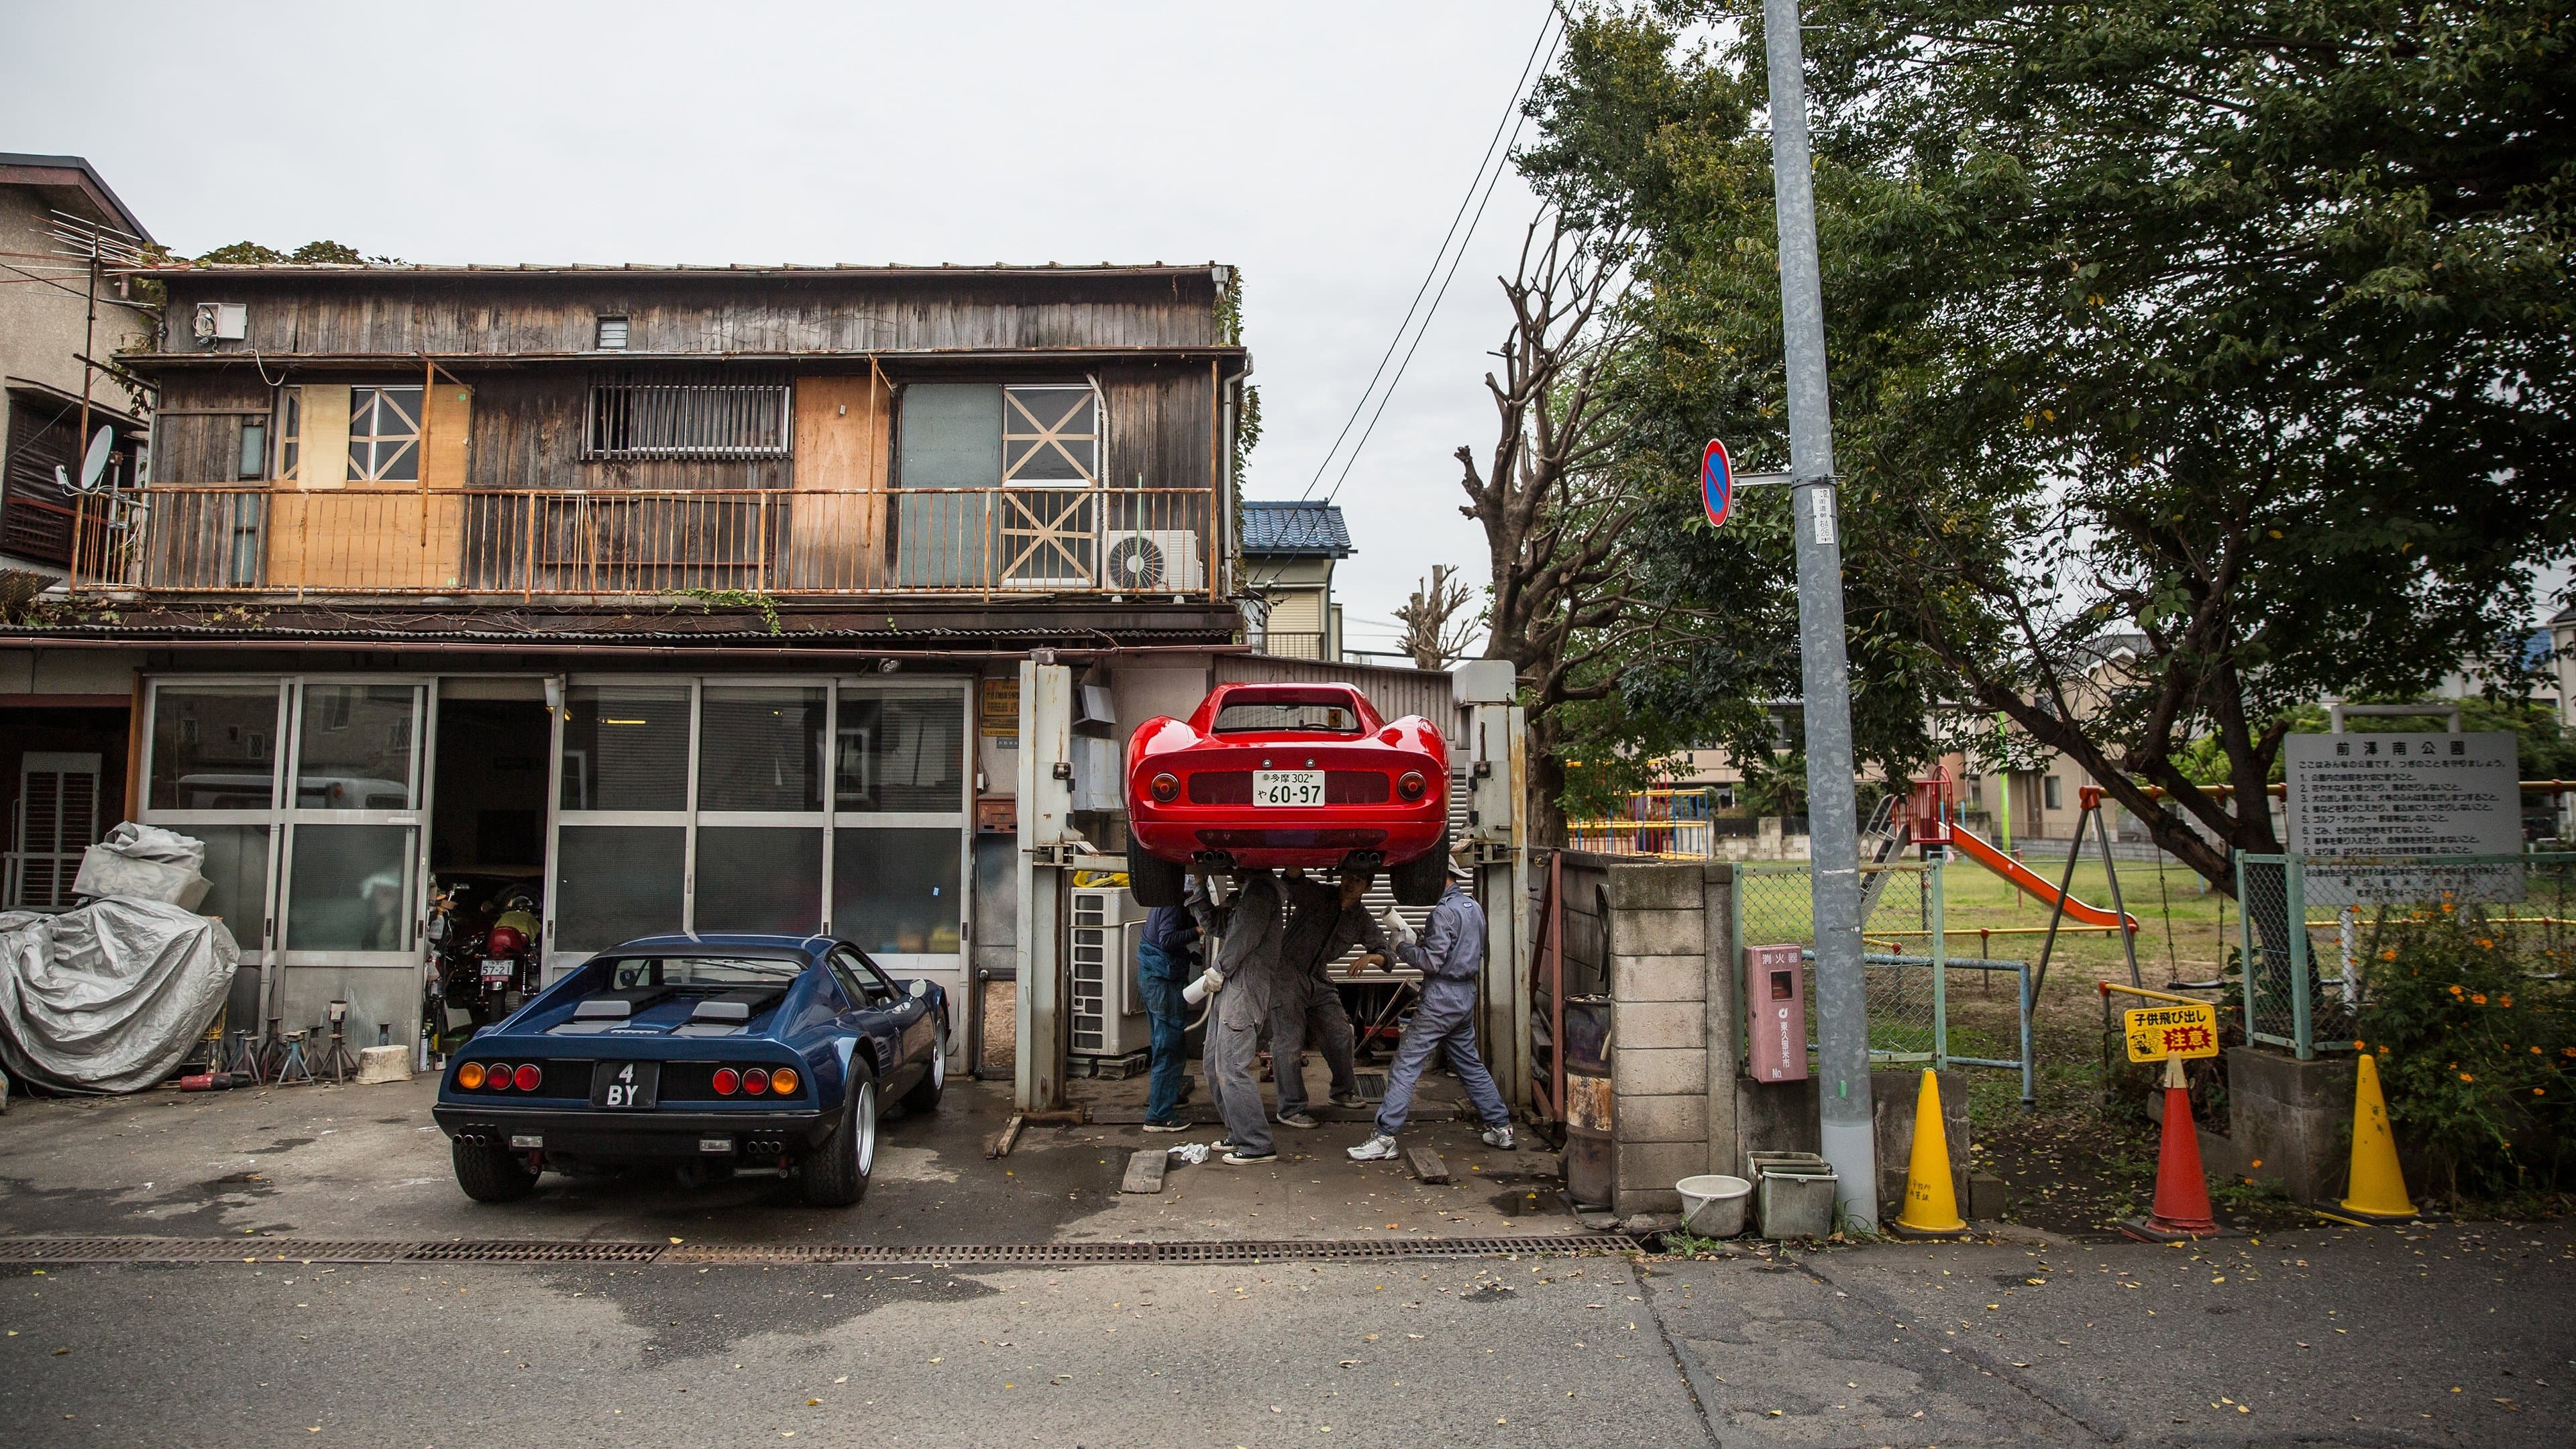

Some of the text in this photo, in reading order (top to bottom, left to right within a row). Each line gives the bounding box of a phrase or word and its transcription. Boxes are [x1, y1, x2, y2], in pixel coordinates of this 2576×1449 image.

[1820, 529, 1830, 537] 26
[1270, 773, 1309, 784] 多摩 302
[1258, 786, 1321, 804] や 60-97
[1762, 953, 1798, 965] 消火器
[482, 966, 510, 975] 57-21
[2134, 1010, 2206, 1026] 子供飛び出し
[1780, 1021, 1790, 1069] 東久留米市
[2169, 1030, 2206, 1047] 注意
[619, 1063, 634, 1083] 4
[607, 1085, 639, 1106] BY
